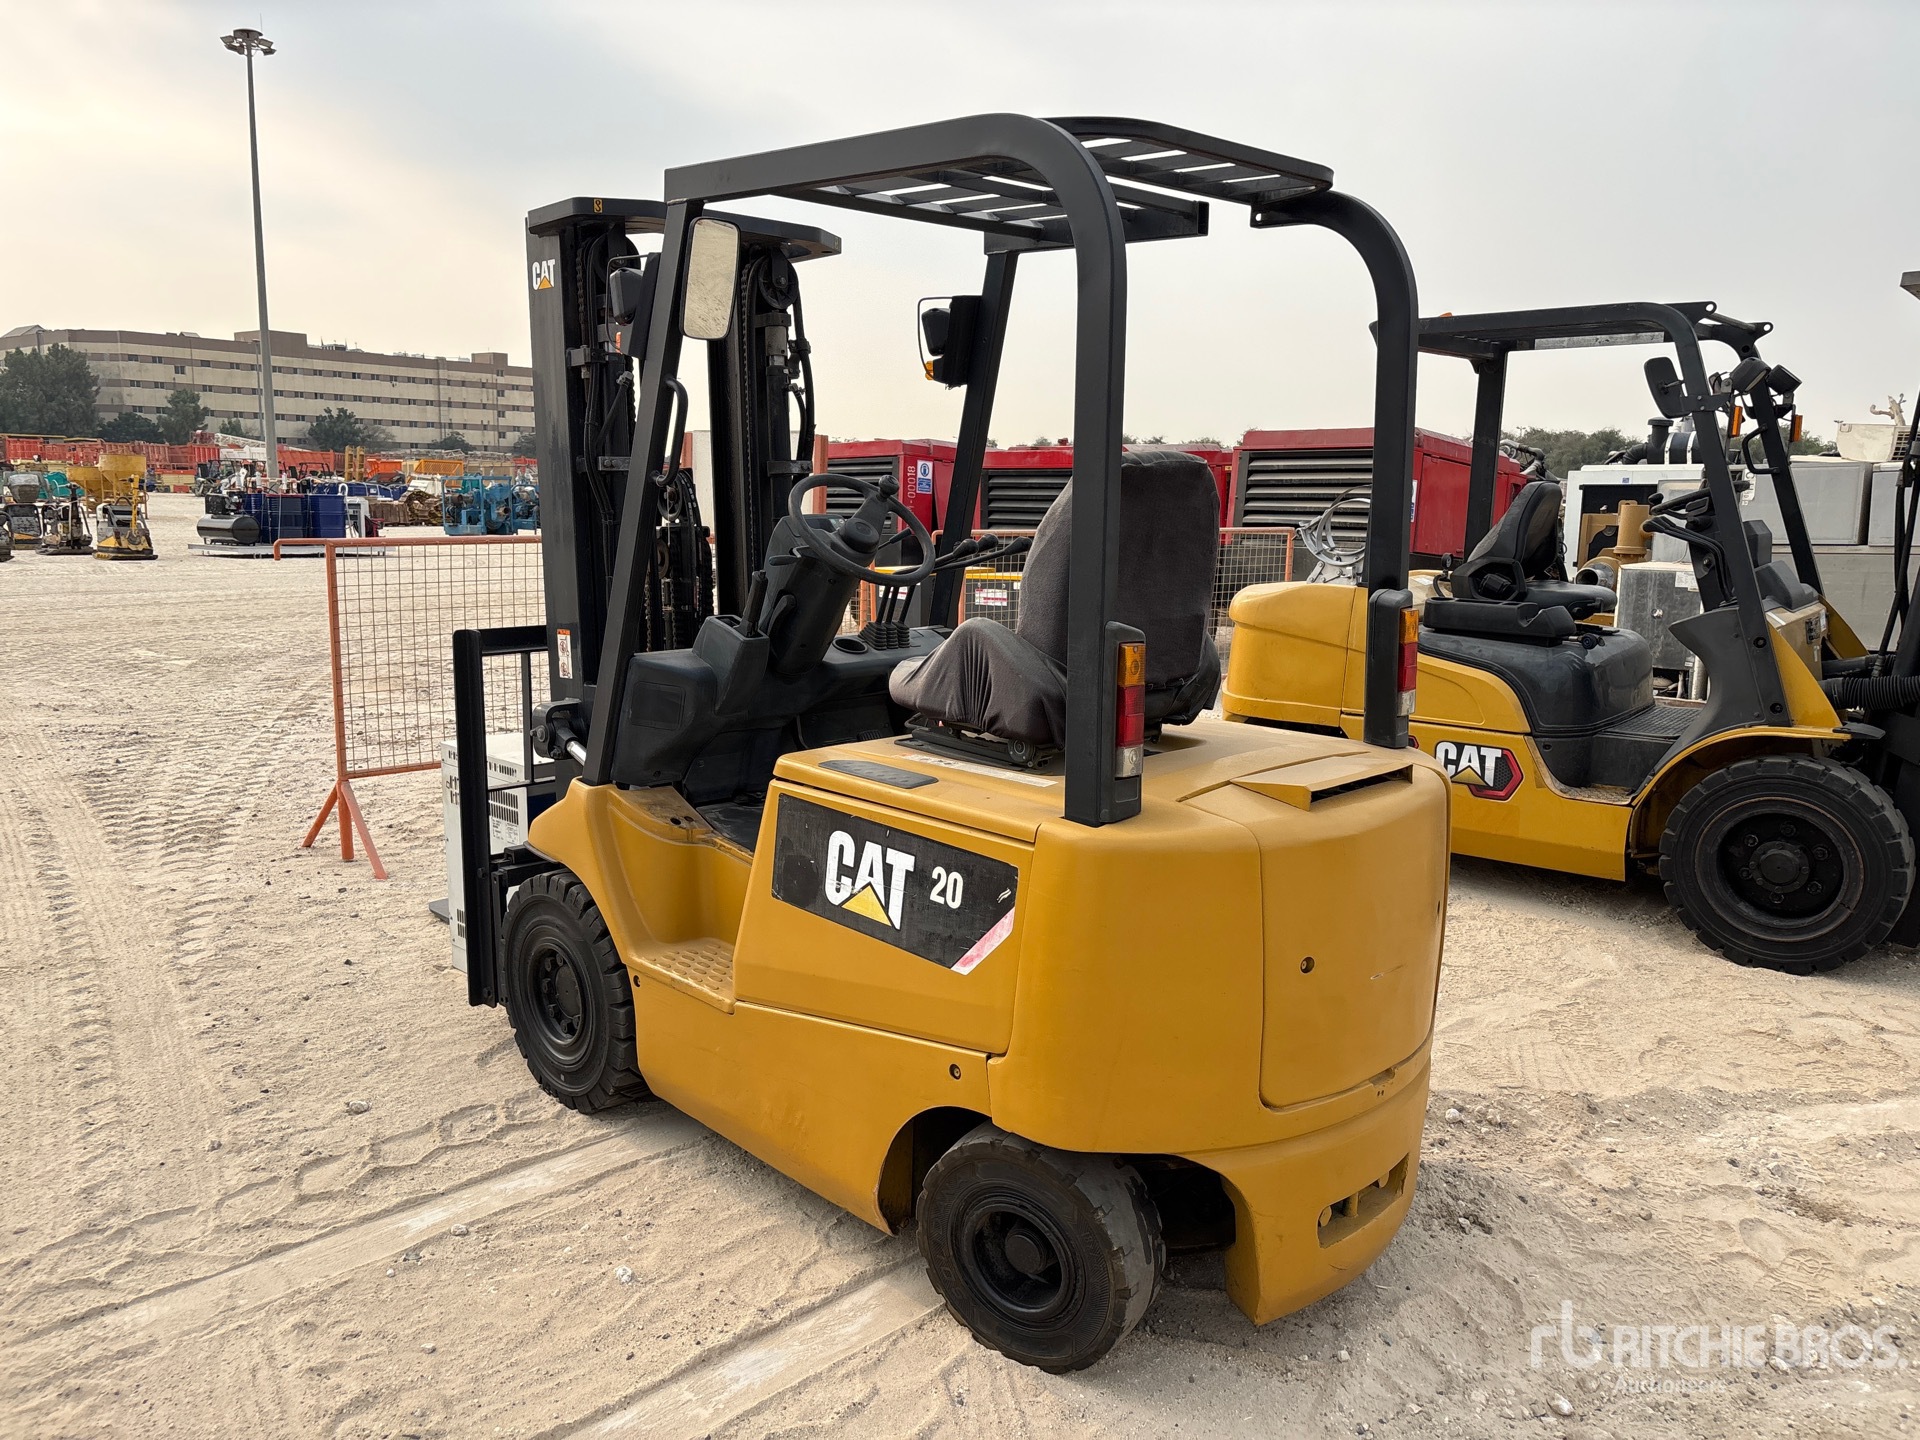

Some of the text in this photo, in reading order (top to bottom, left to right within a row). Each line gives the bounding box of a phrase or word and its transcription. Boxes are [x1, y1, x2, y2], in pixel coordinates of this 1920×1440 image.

[532, 259, 556, 290] CAT
[1436, 742, 1502, 787] CAT
[825, 830, 964, 930] CAT 20
